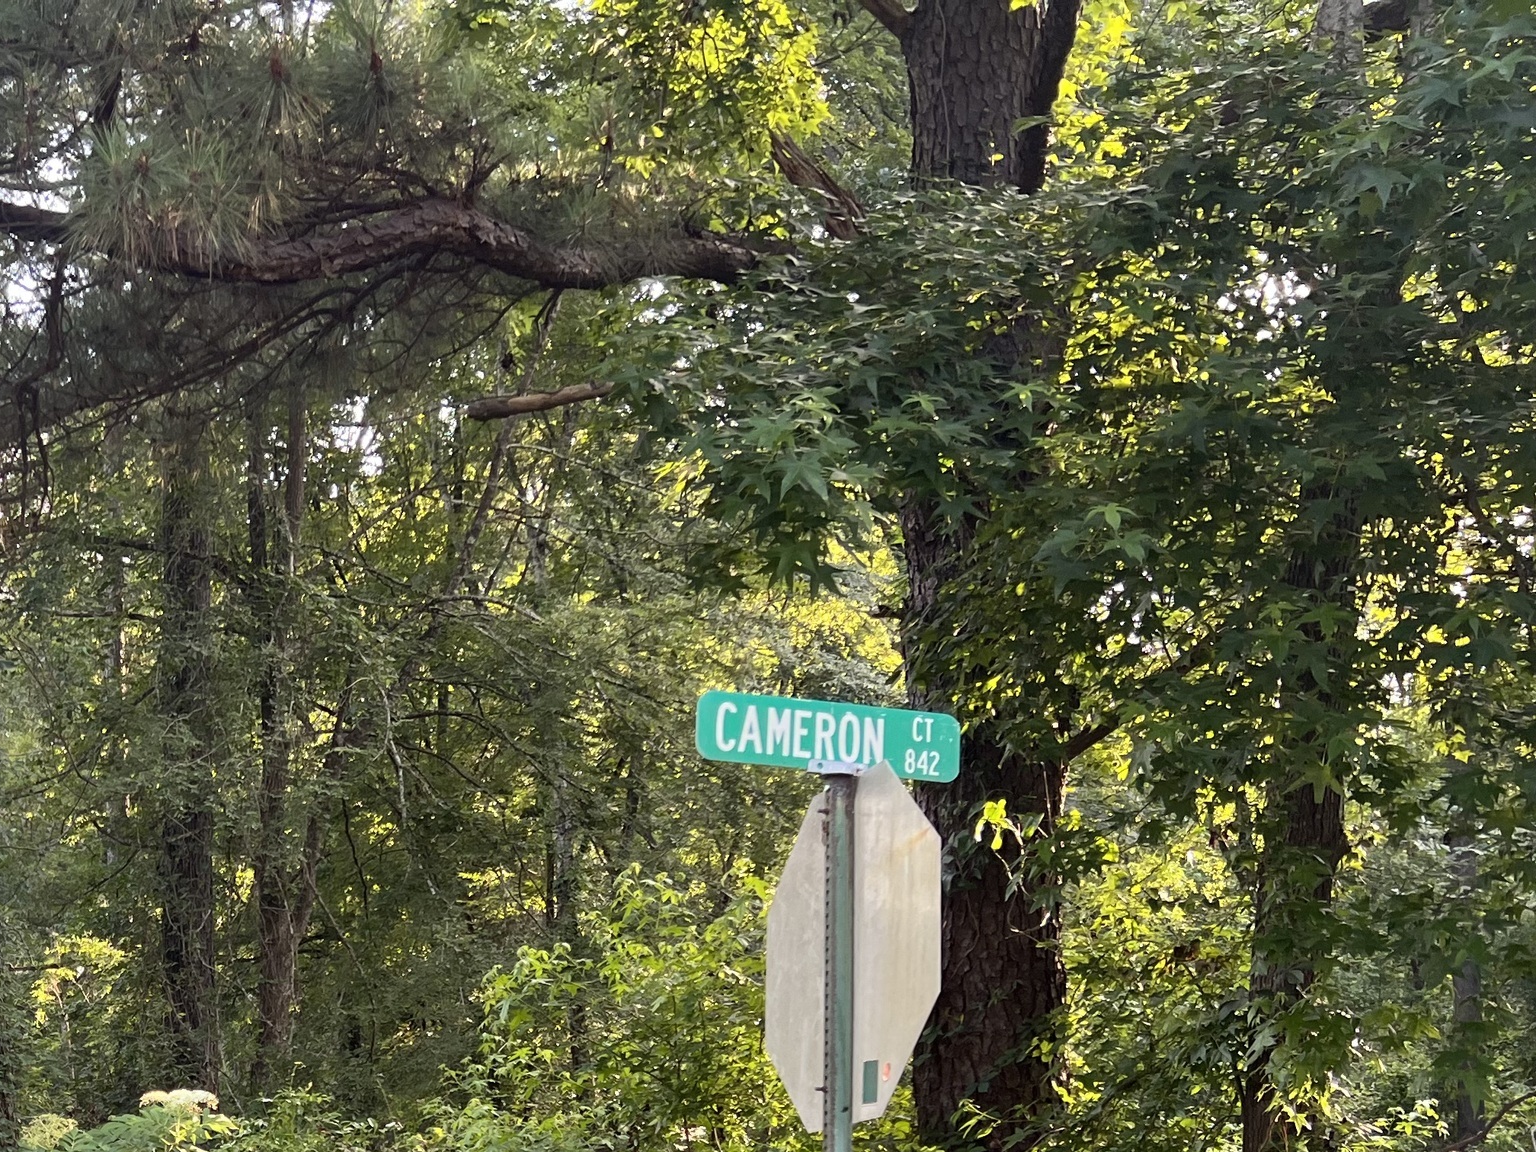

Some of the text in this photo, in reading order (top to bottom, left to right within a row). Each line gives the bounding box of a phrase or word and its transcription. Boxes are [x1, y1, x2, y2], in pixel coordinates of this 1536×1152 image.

[715, 701, 934, 765] CAMERON CT
[904, 748, 940, 776] 842
